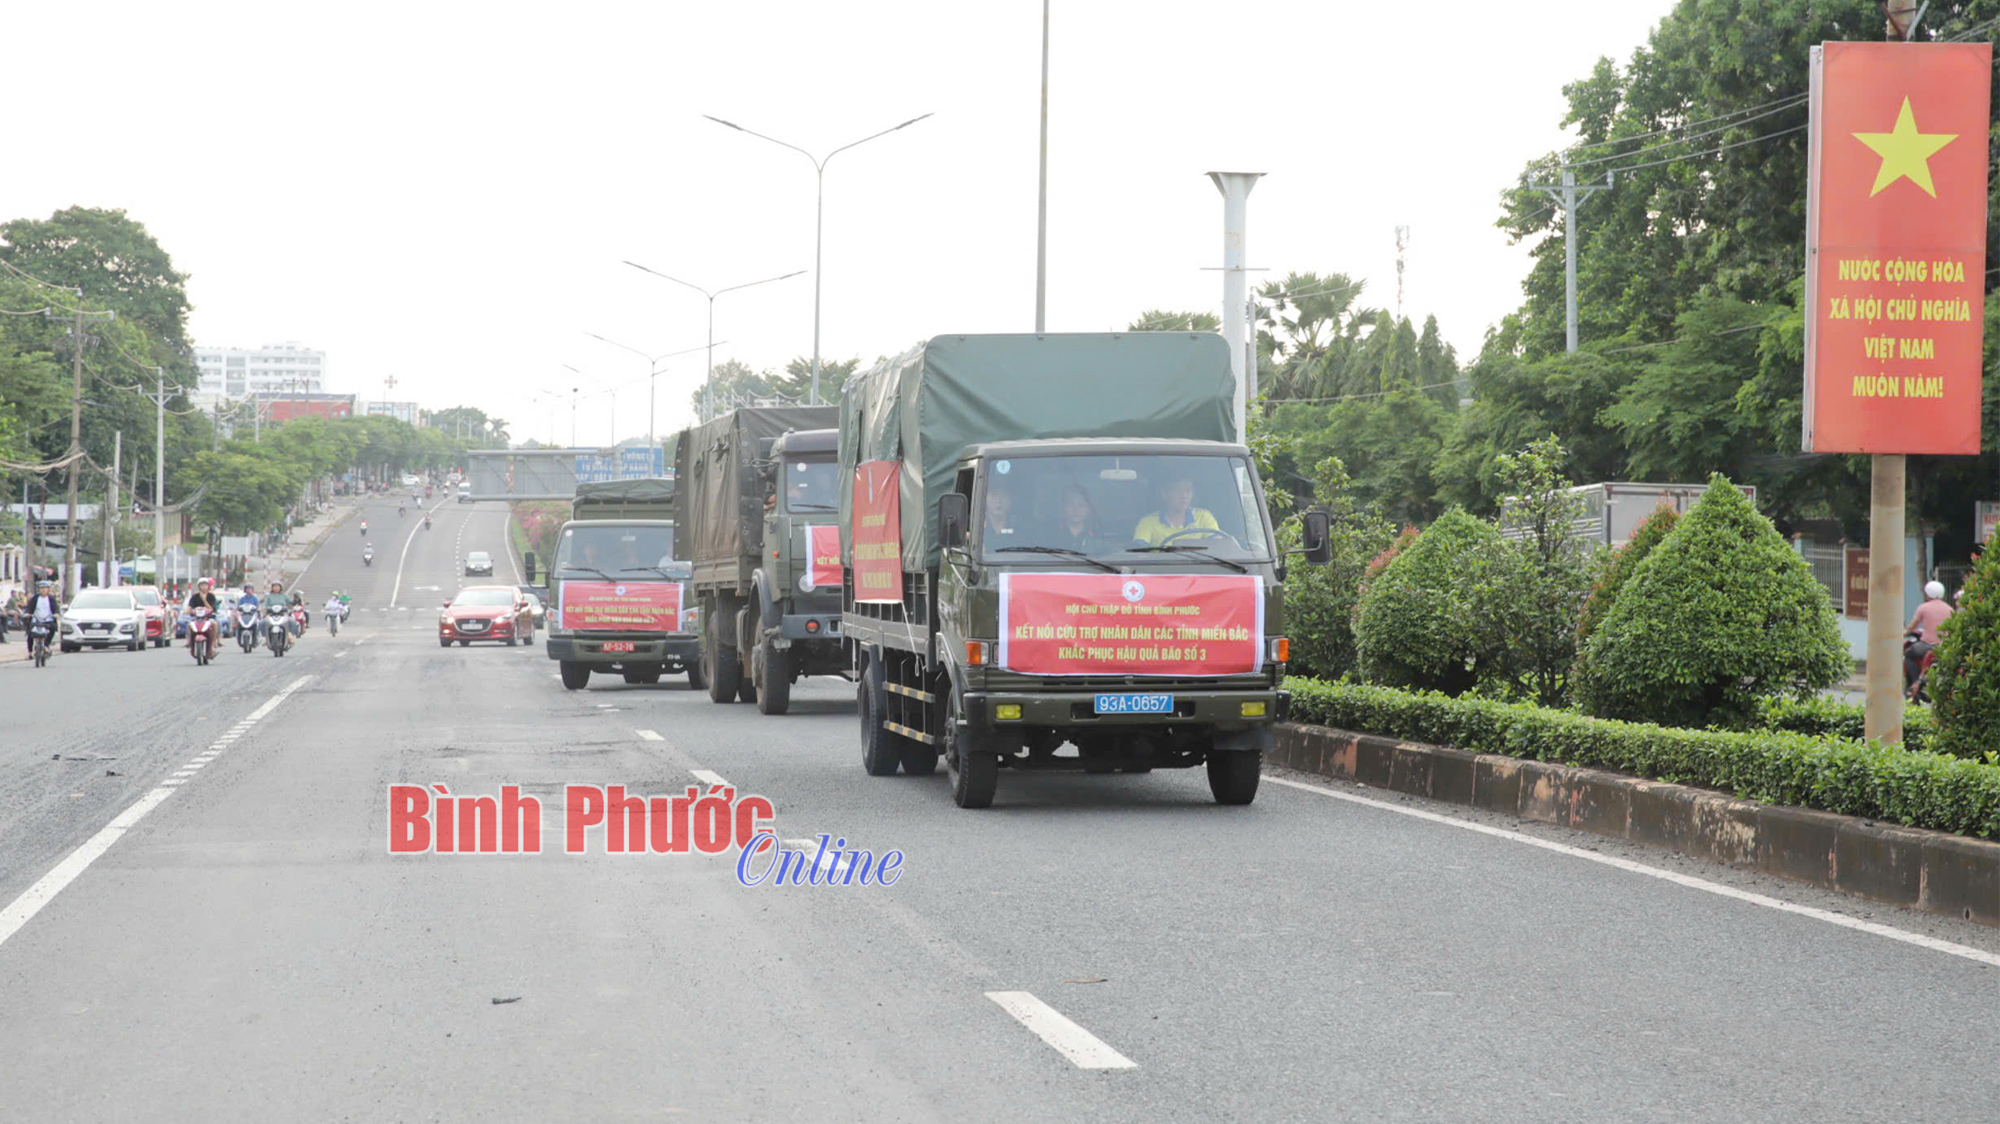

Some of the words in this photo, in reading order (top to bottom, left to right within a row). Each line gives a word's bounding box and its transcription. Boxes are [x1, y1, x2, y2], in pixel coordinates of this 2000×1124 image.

[1839, 255, 1880, 281] NƯỚC
[1885, 256, 1928, 287] CỘNG
[1932, 257, 1965, 283] HÒA
[1854, 295, 1882, 325] HỘI
[1886, 293, 1917, 321] CHỦ
[1921, 296, 1971, 321] NGHĨA
[1864, 333, 1895, 364] VIỆT
[1900, 338, 1934, 359] NAM
[1852, 372, 1899, 397] MUÔN
[1904, 373, 1944, 398] NĂM!
[1066, 603, 1079, 616] HỘI
[1081, 604, 1098, 614] CHỮ
[1100, 604, 1119, 616] THẬP
[1121, 603, 1132, 615] ĐỎ
[1134, 603, 1152, 615] TỈNH
[1174, 604, 1200, 615] PHƯỚC
[1016, 622, 1034, 639] KẾT
[1036, 622, 1054, 639] NỐI
[1057, 623, 1077, 639] CỨU
[1079, 626, 1098, 642] TRỢ
[1100, 624, 1128, 639] NHÂN
[1131, 624, 1151, 640] DÂN
[1154, 624, 1174, 640] CÁC
[1176, 623, 1198, 640] TỈNH
[1202, 624, 1226, 640] MIỀN
[1229, 624, 1249, 641] BẮC
[1059, 642, 1085, 659] KHẮC
[1088, 647, 1114, 663] PHỤC
[1116, 645, 1137, 663] HẬU
[1139, 643, 1159, 661] QUẢ
[1161, 646, 1181, 660] BÃO
[1183, 644, 1198, 660] SỐ
[1199, 648, 1206, 660] 3
[1100, 696, 1169, 711] 93A-0657
